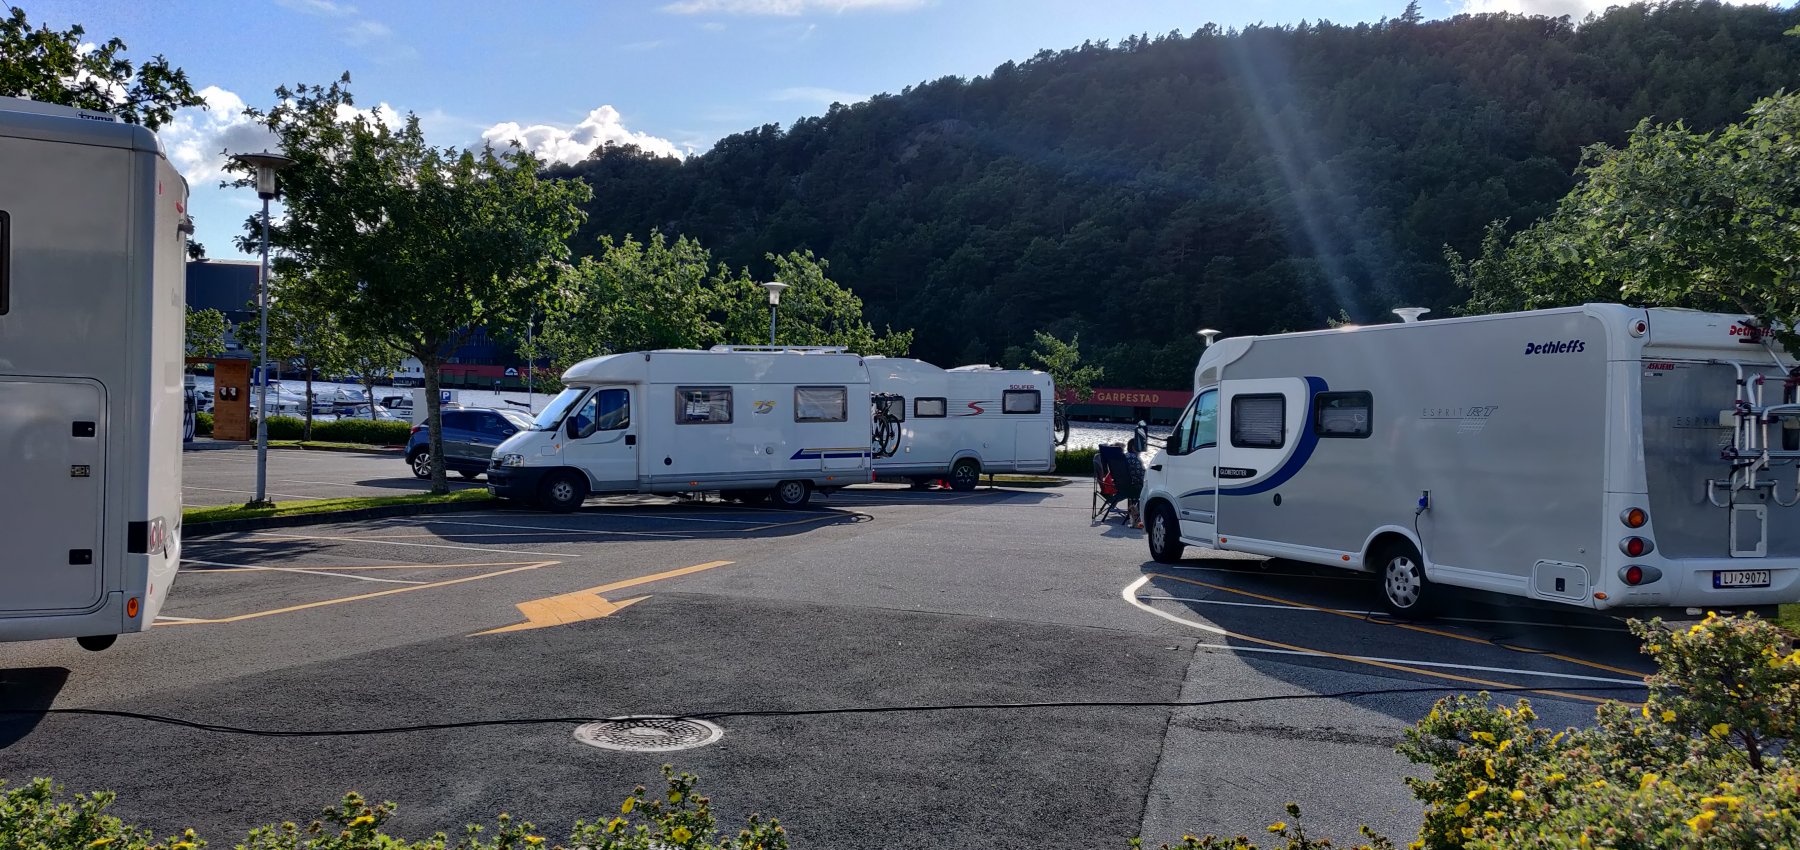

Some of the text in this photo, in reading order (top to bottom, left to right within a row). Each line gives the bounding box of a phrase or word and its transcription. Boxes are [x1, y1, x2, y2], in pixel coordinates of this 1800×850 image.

[1525, 339, 1585, 355] Dethleffs
[1097, 392, 1160, 404] GARPESTAD
[1423, 405, 1499, 417] ESPRIT RT
[1723, 571, 1767, 585] LJ 29072
